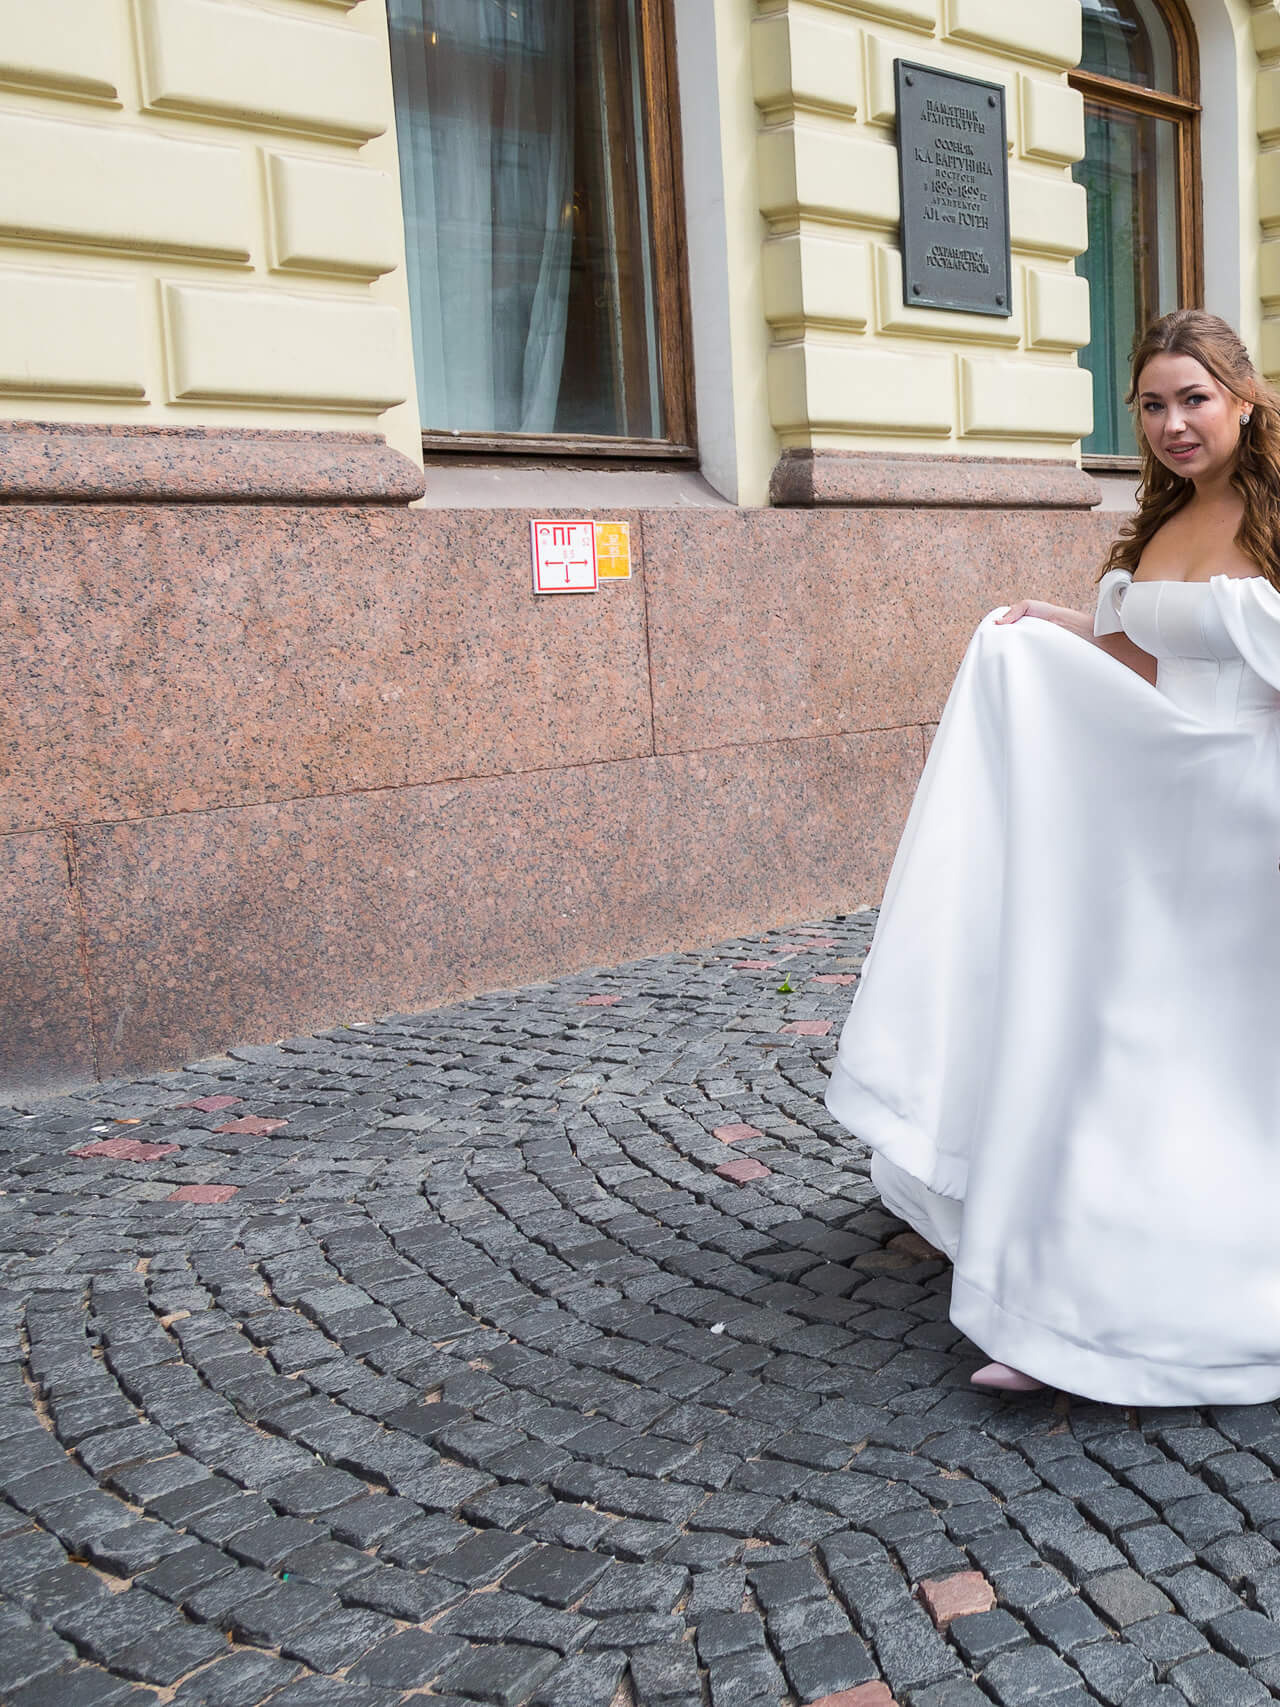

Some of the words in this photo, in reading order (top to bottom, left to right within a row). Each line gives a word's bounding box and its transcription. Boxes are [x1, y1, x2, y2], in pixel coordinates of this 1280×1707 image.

[926, 99, 979, 122] ПАМЯТНИК
[920, 110, 985, 134] АРХИТЕКТУРЫ
[931, 246, 984, 263] ОХРАНЯЕТСЯ
[926, 255, 990, 274] ГОСУДАРСТВОМ
[552, 527, 577, 546] ПГ
